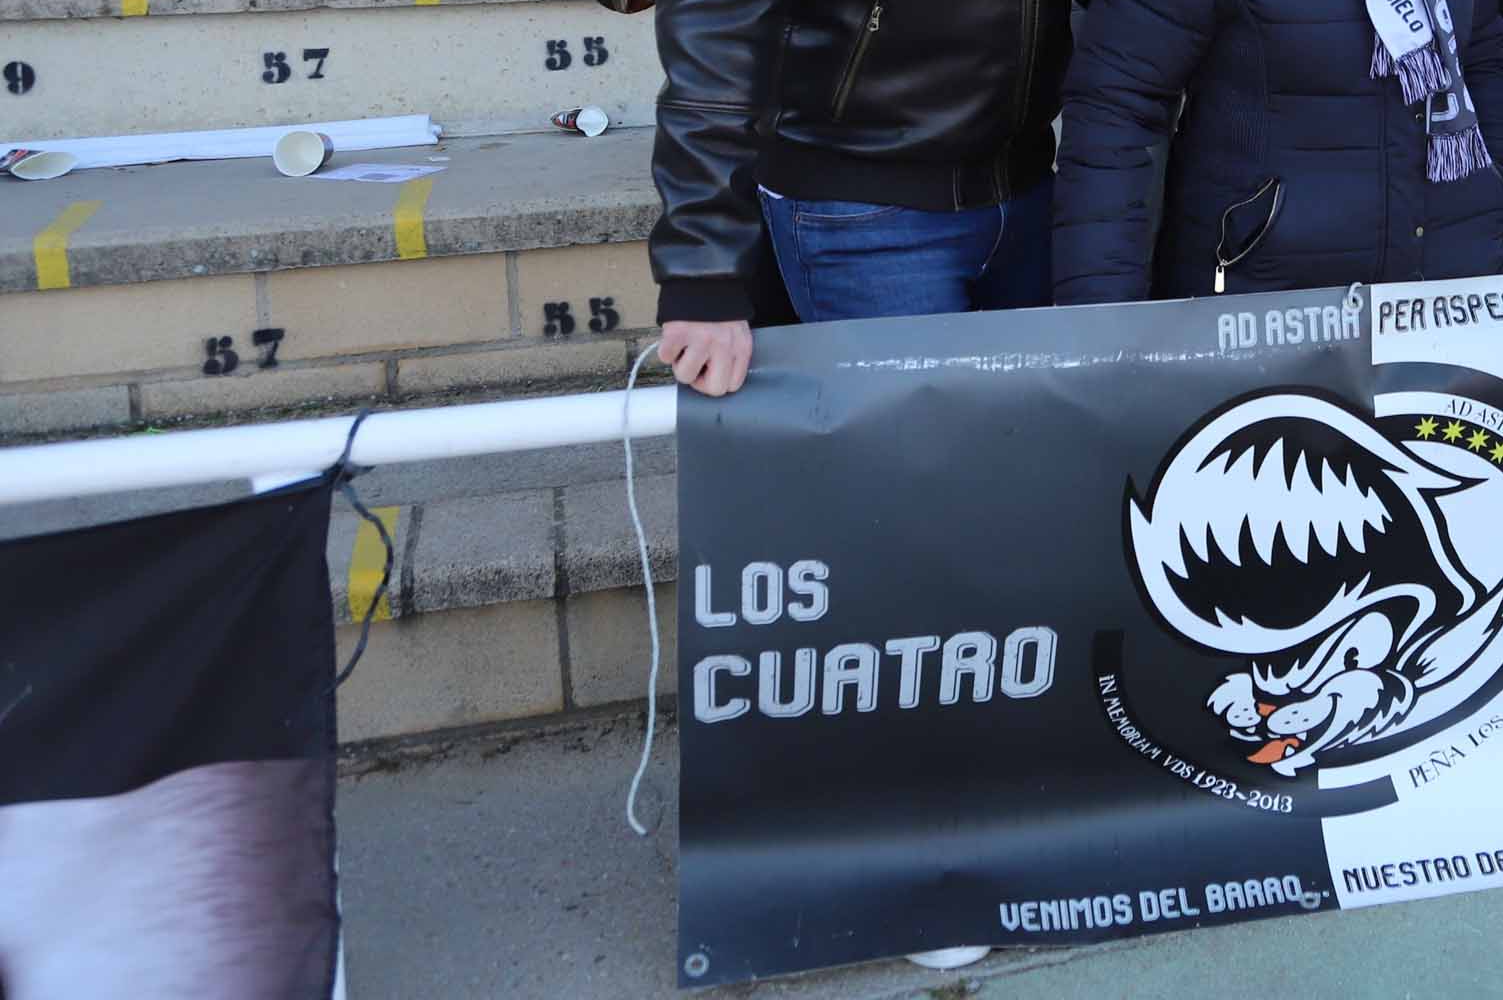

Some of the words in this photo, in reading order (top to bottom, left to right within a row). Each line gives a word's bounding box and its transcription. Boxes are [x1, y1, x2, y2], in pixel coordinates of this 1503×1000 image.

[262, 47, 330, 84] 57
[545, 36, 609, 72] 55
[542, 297, 620, 337] 55
[1217, 311, 1258, 350] AD
[1265, 304, 1361, 346] ASTRA
[1378, 297, 1427, 335] PER
[202, 328, 285, 376] 57
[1447, 399, 1473, 417] AD
[694, 559, 830, 628] LOS
[693, 625, 1059, 724] CUATRO
[1162, 754, 1195, 779] VDS
[1408, 745, 1466, 789] PEÑA
[999, 894, 1134, 932] VENIMOS
[1139, 887, 1201, 923] DEL
[1342, 854, 1471, 894] NUESTRO
